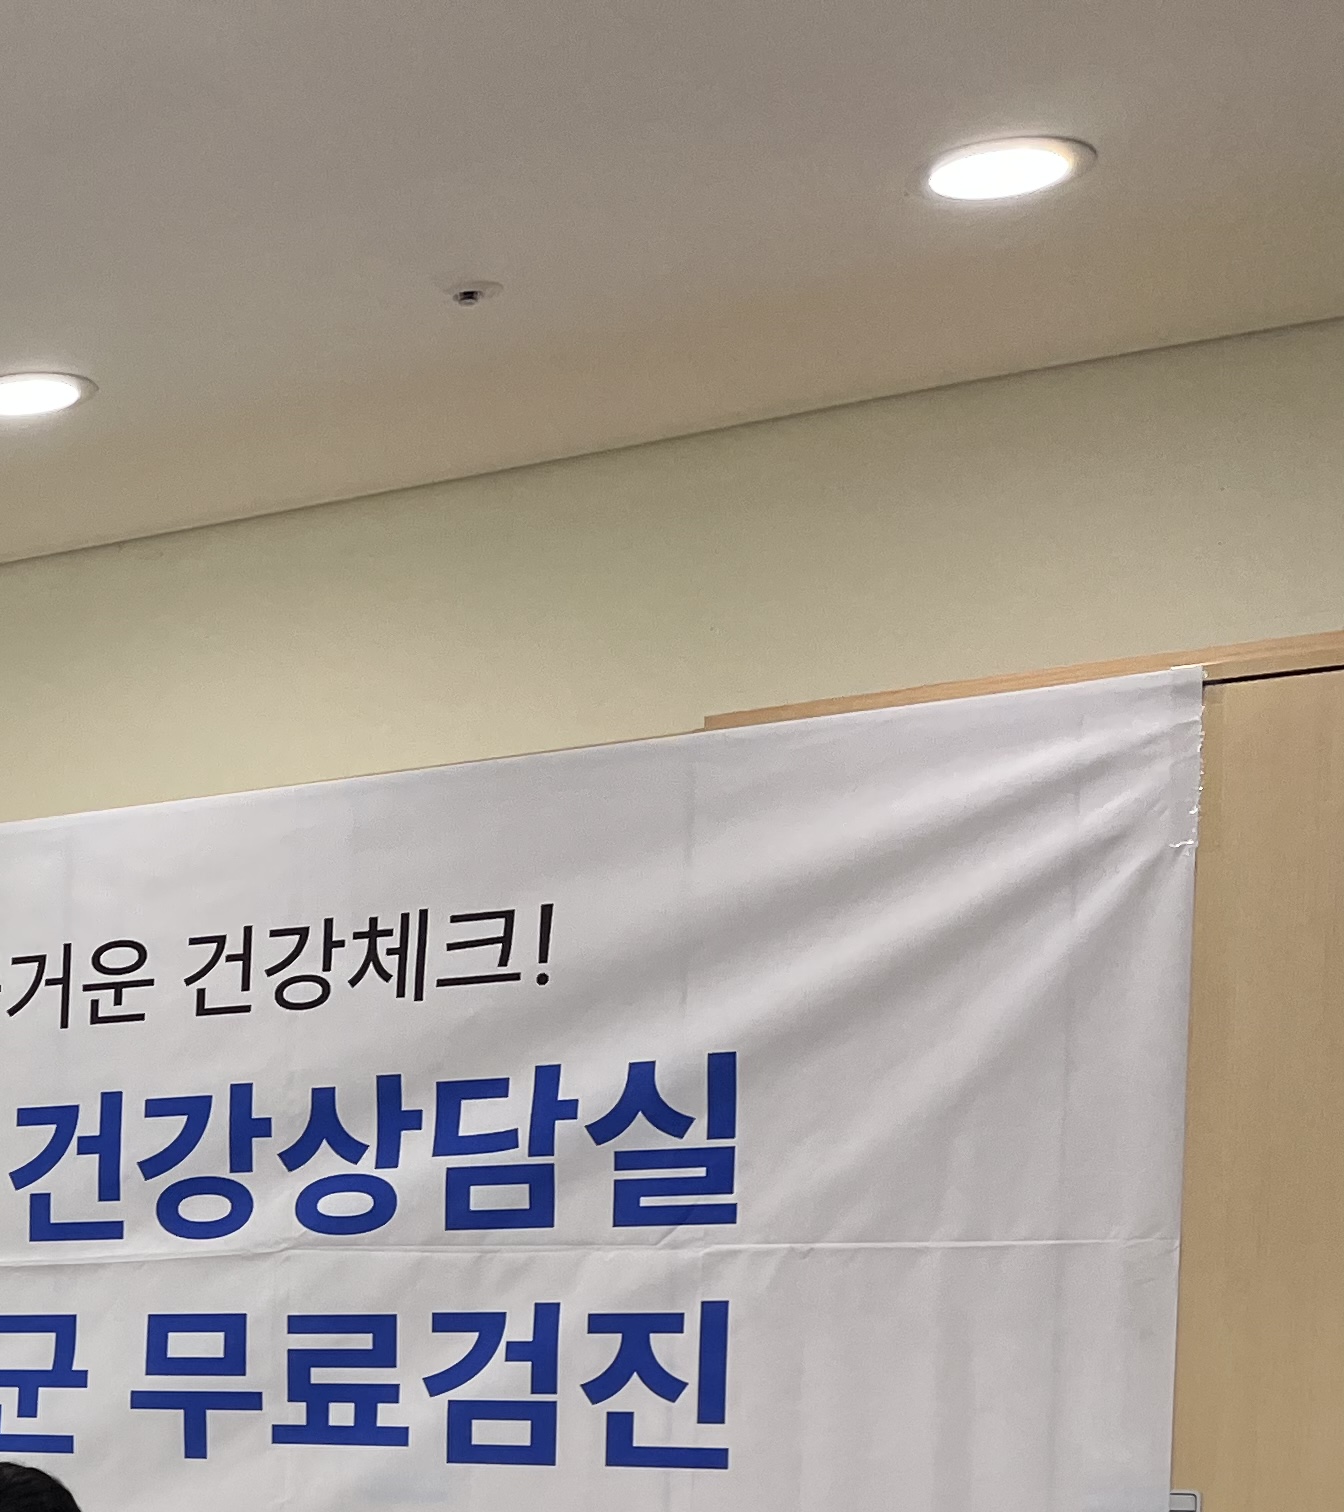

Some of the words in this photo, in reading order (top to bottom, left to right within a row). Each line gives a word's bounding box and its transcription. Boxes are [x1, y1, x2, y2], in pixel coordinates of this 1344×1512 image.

[183, 903, 554, 1017] 건강체크!
[10, 1052, 737, 1242] 건강상담실
[131, 1301, 729, 1469] 무료검진
